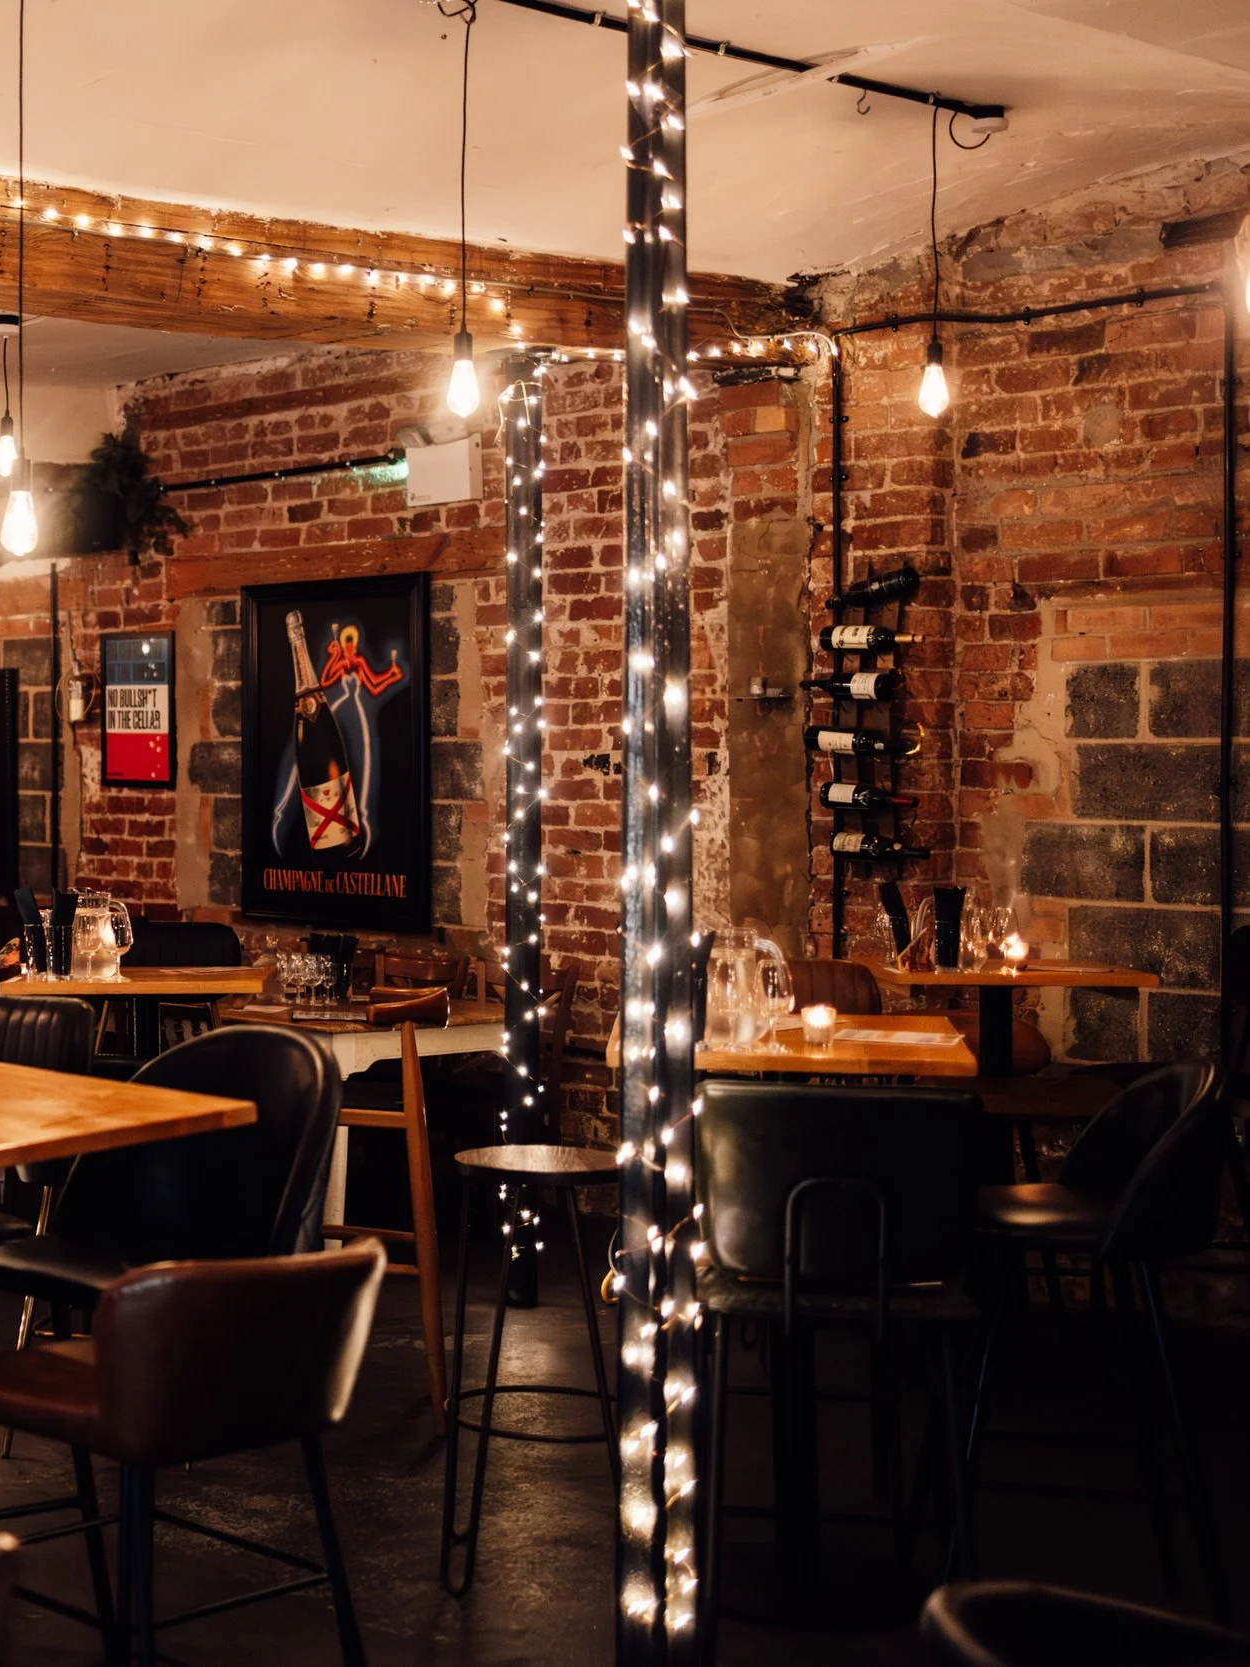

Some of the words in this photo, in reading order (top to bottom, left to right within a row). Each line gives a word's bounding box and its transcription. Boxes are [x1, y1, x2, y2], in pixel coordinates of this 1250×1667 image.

[108, 688, 118, 708] NO
[108, 710, 116, 729] IN
[117, 710, 131, 729] THE
[132, 710, 161, 729] CELLAR
[263, 868, 324, 893] CHAMPAGNE
[336, 871, 407, 898] CASTELLANE
